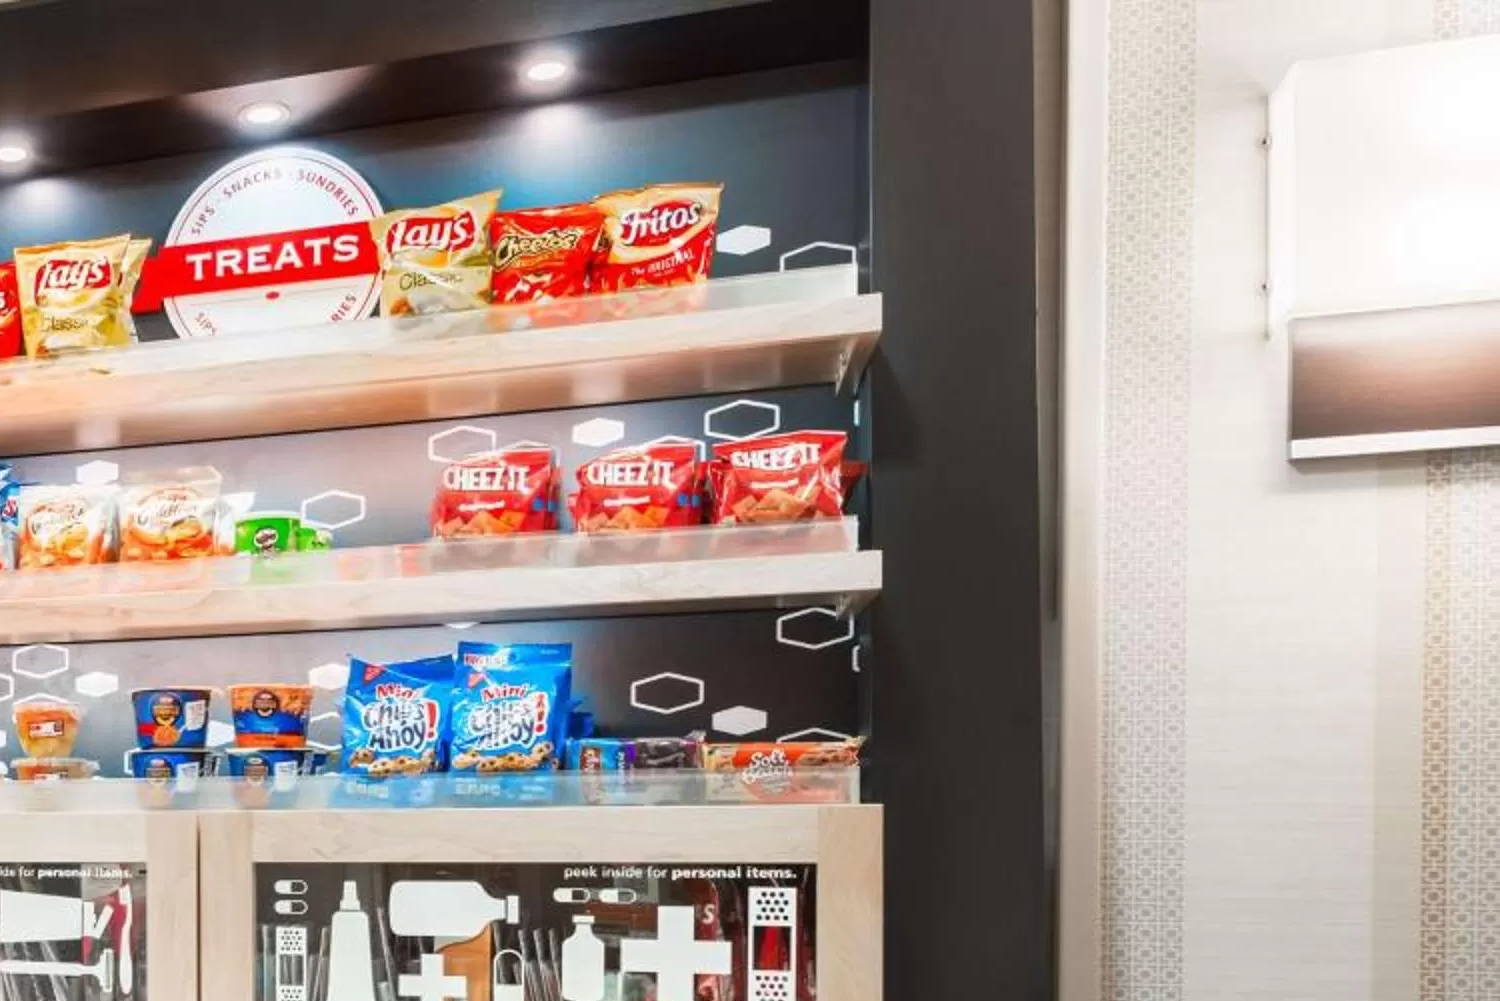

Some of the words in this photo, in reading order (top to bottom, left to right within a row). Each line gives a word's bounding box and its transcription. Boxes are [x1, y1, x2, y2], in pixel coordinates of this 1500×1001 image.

[222, 166, 283, 199] SNACKS
[297, 168, 359, 217] SUNDRIES
[620, 200, 701, 244] Fritos
[185, 234, 360, 281] TREATS
[19, 866, 35, 877] for
[37, 866, 91, 879] personal
[563, 865, 598, 880] peek
[601, 865, 643, 878] inside
[648, 865, 667, 878] for
[671, 865, 741, 880] personal
[746, 865, 797, 879] items.
